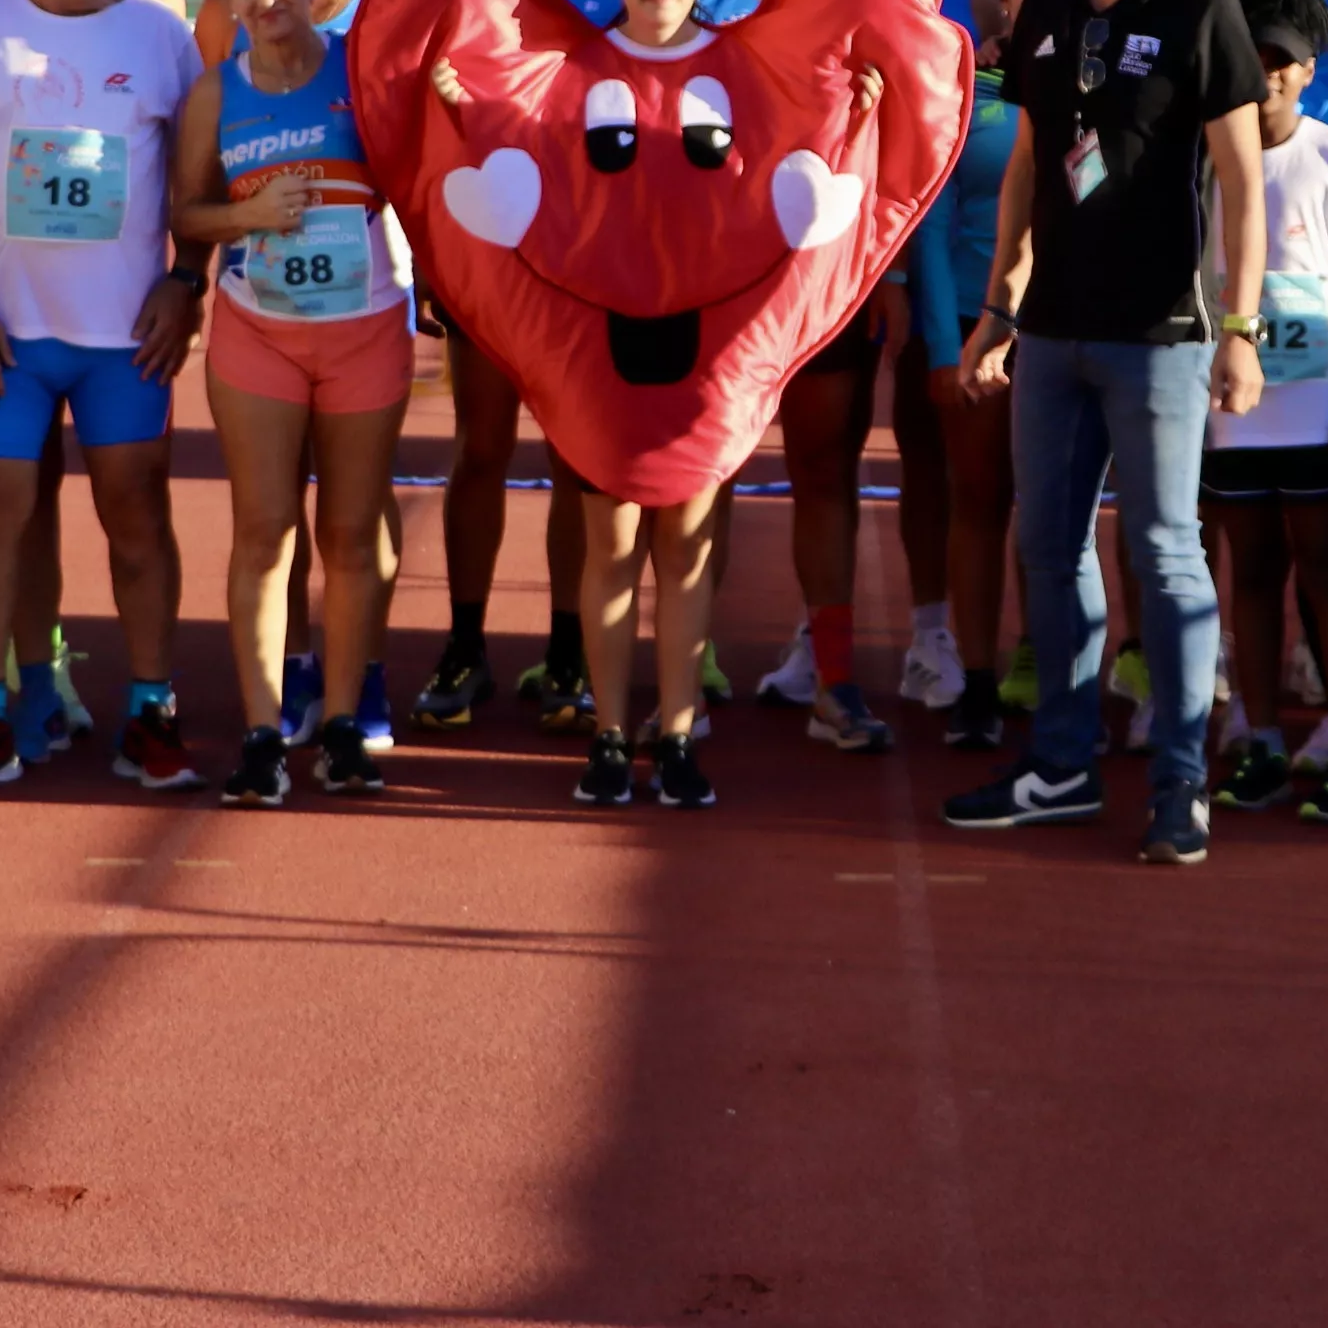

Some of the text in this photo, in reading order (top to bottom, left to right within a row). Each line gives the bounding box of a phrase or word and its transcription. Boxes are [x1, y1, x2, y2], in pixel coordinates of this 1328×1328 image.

[221, 124, 327, 169] nerplus
[43, 175, 91, 207] 18
[284, 253, 334, 286] 88
[1267, 318, 1309, 349] 12
